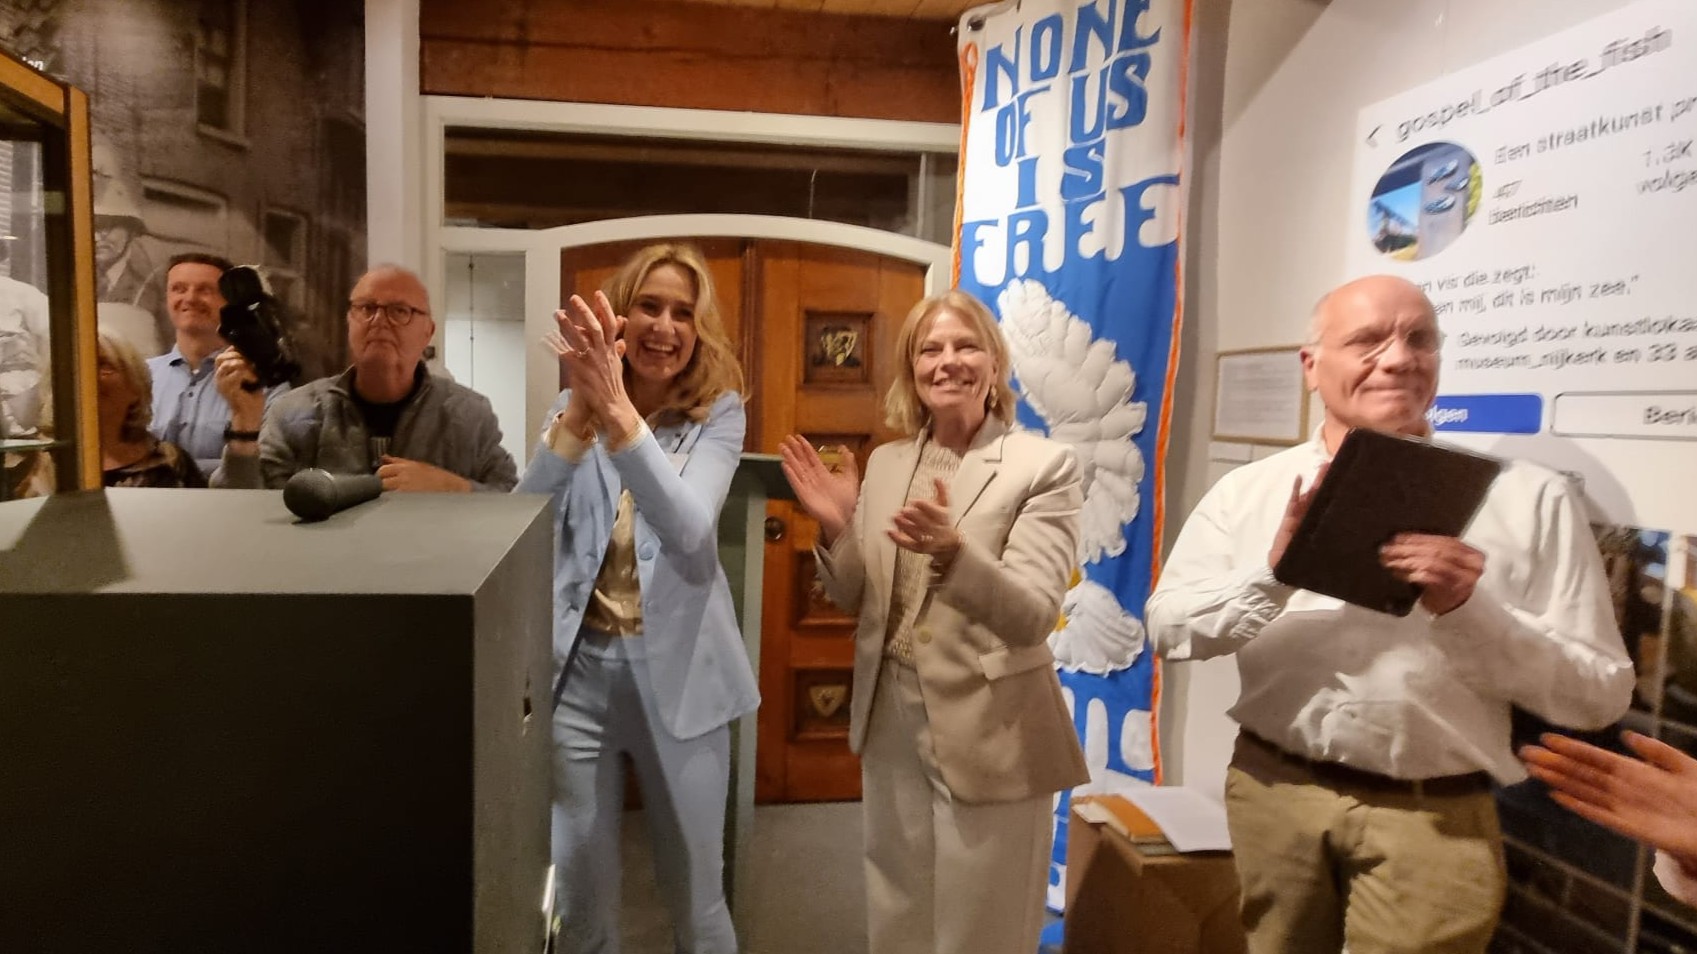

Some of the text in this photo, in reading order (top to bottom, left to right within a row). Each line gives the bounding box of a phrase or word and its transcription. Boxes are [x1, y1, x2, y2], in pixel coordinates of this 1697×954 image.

[981, 0, 1162, 112] NONE
[995, 52, 1150, 167] OF US
[1494, 145, 1530, 165] Een
[1536, 105, 1663, 153] straatkunst
[960, 173, 1180, 288] FREE
[1463, 270, 1489, 289] die
[1519, 288, 1535, 305] is
[1540, 282, 1582, 306] mijn
[1532, 325, 1577, 342] door
[1613, 349, 1641, 363] en
